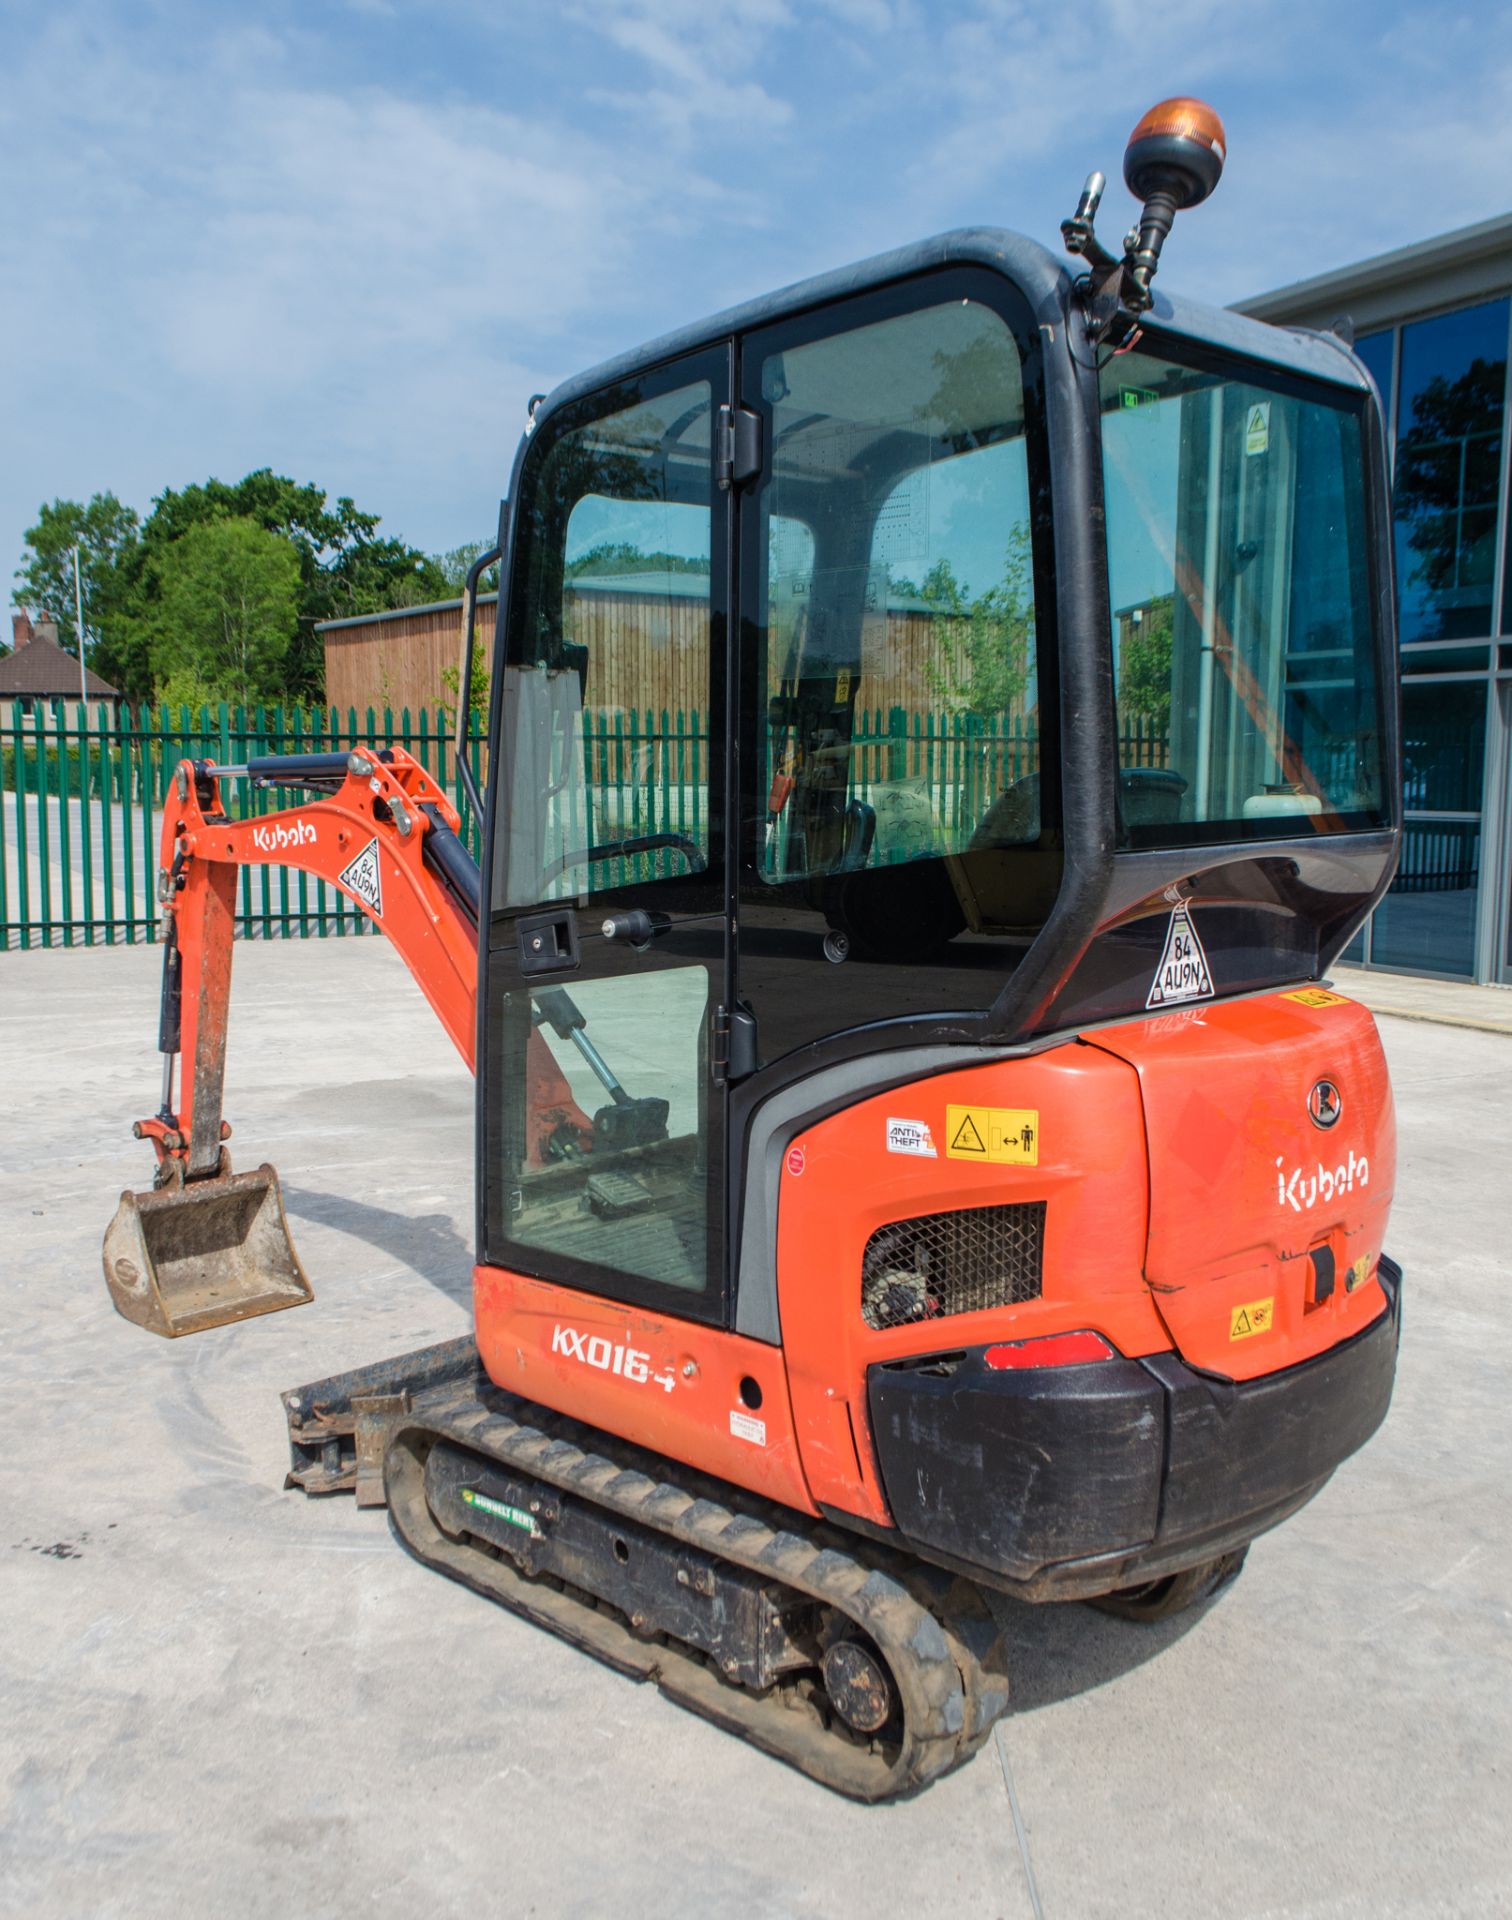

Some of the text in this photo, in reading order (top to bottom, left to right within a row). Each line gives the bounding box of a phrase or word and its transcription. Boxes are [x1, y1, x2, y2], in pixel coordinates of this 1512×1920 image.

[253, 819, 317, 851] Kubota
[360, 859, 374, 877] 84
[351, 868, 377, 901] AU9N
[1174, 935, 1191, 961] 84
[1165, 961, 1200, 992] AU9N
[889, 1136, 921, 1148] THEFT
[1276, 1150, 1369, 1212] Kubota
[552, 1324, 676, 1393] KX016-4
